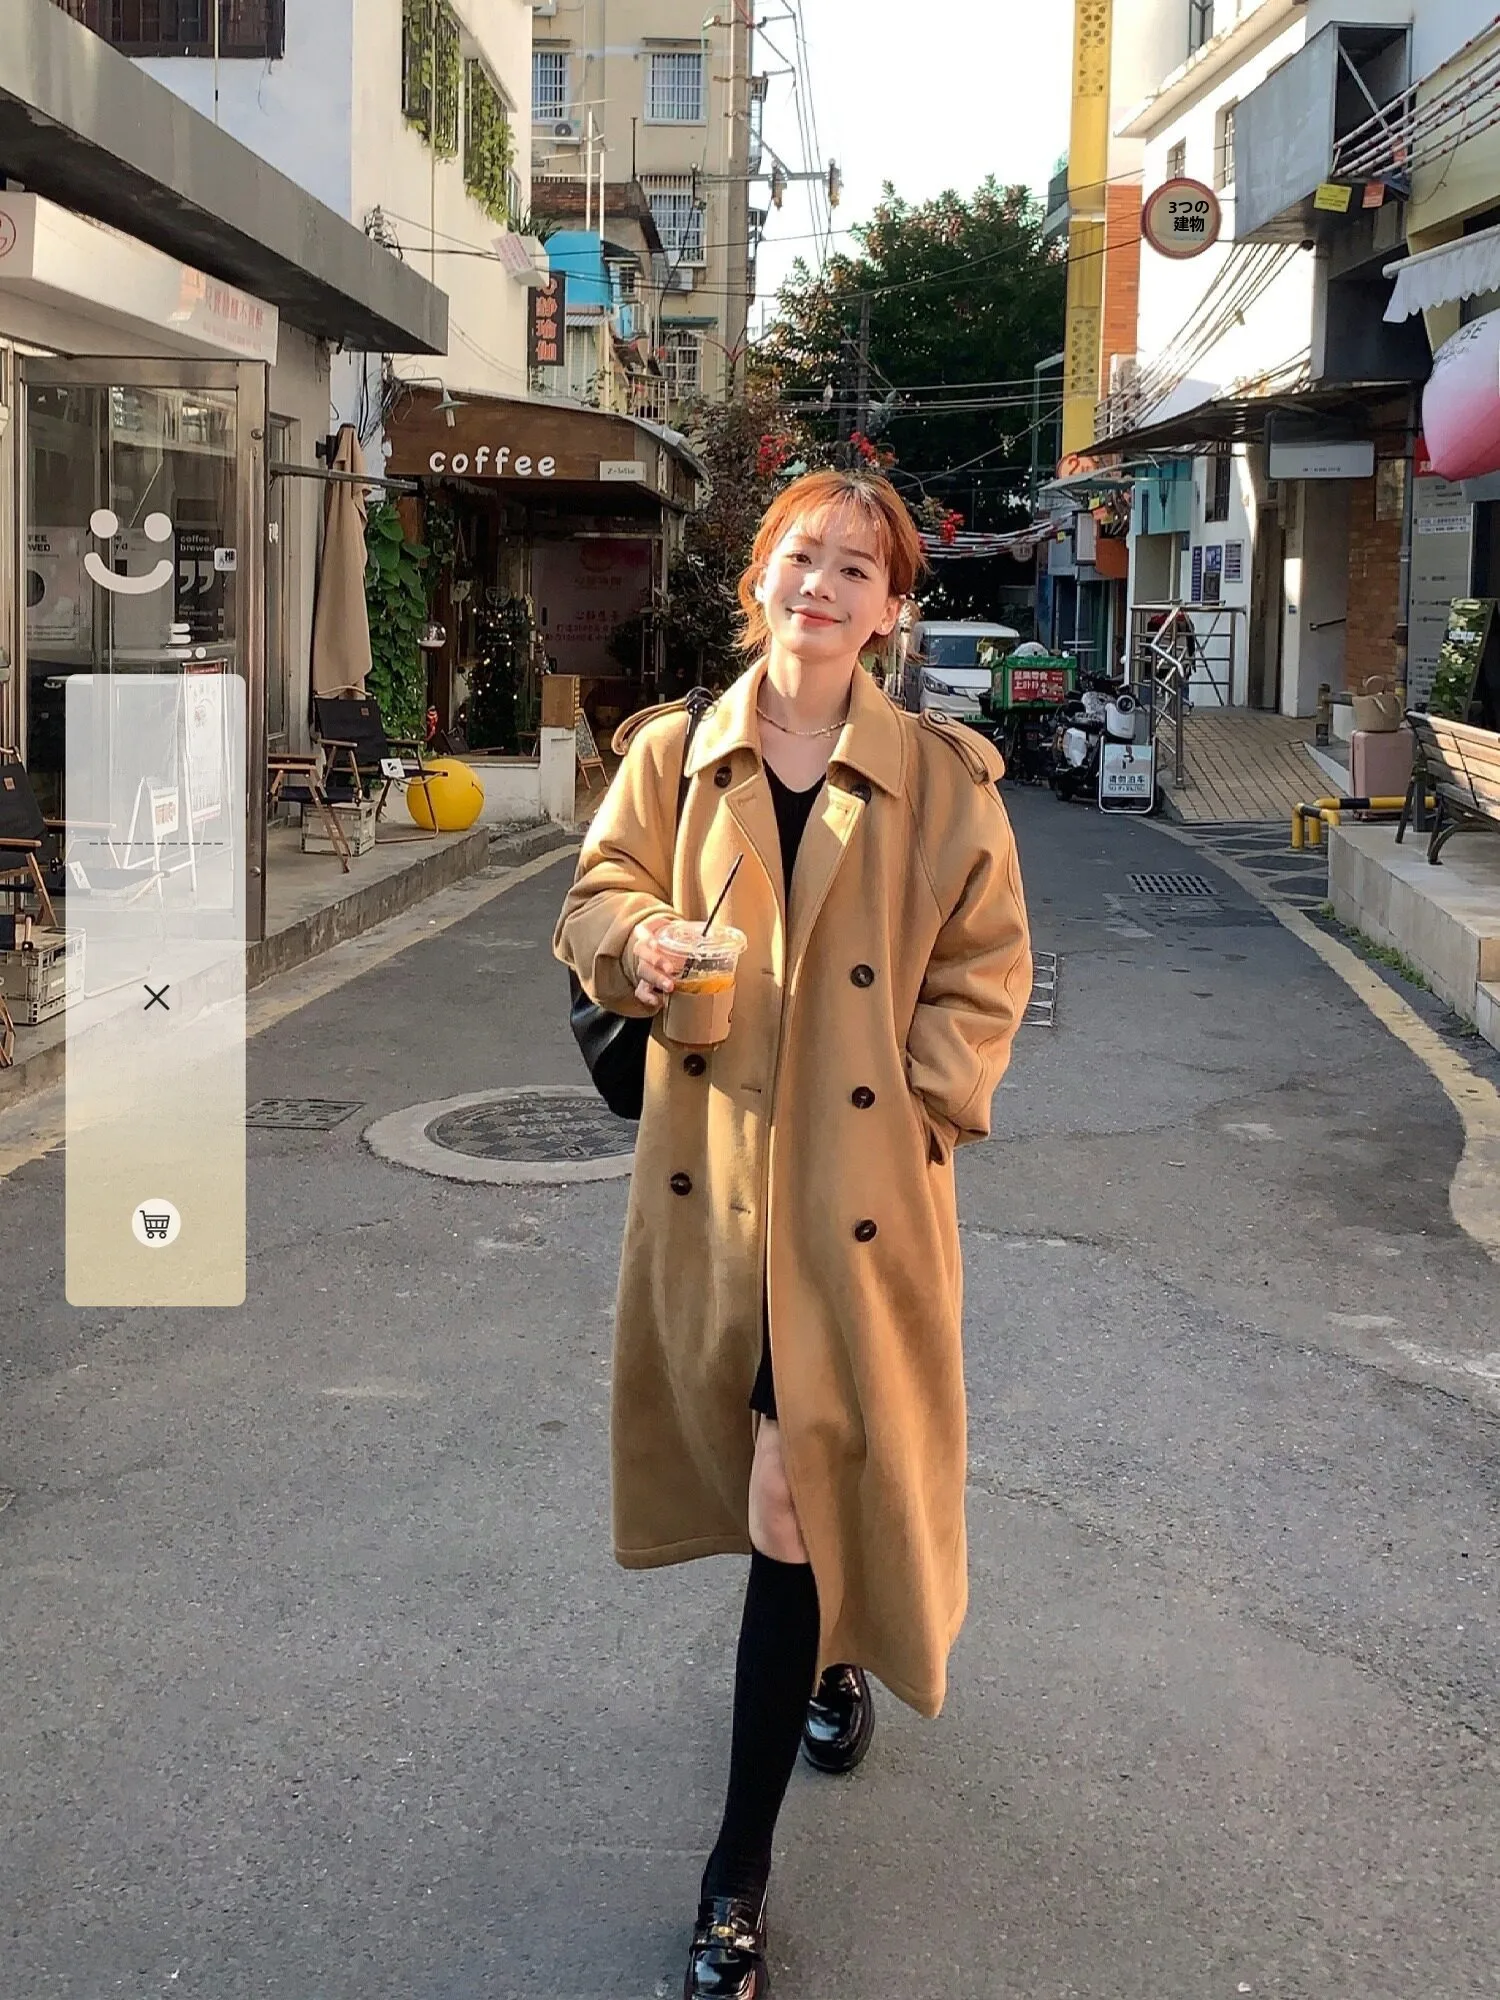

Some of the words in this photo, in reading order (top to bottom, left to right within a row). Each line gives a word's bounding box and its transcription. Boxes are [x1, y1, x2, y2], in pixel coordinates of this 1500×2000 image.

[1168, 200, 1210, 214] 3つの
[1173, 216, 1205, 233] 建物
[429, 445, 556, 477] coffee
[180, 535, 210, 543] coffee
[180, 543, 216, 552] brewed
